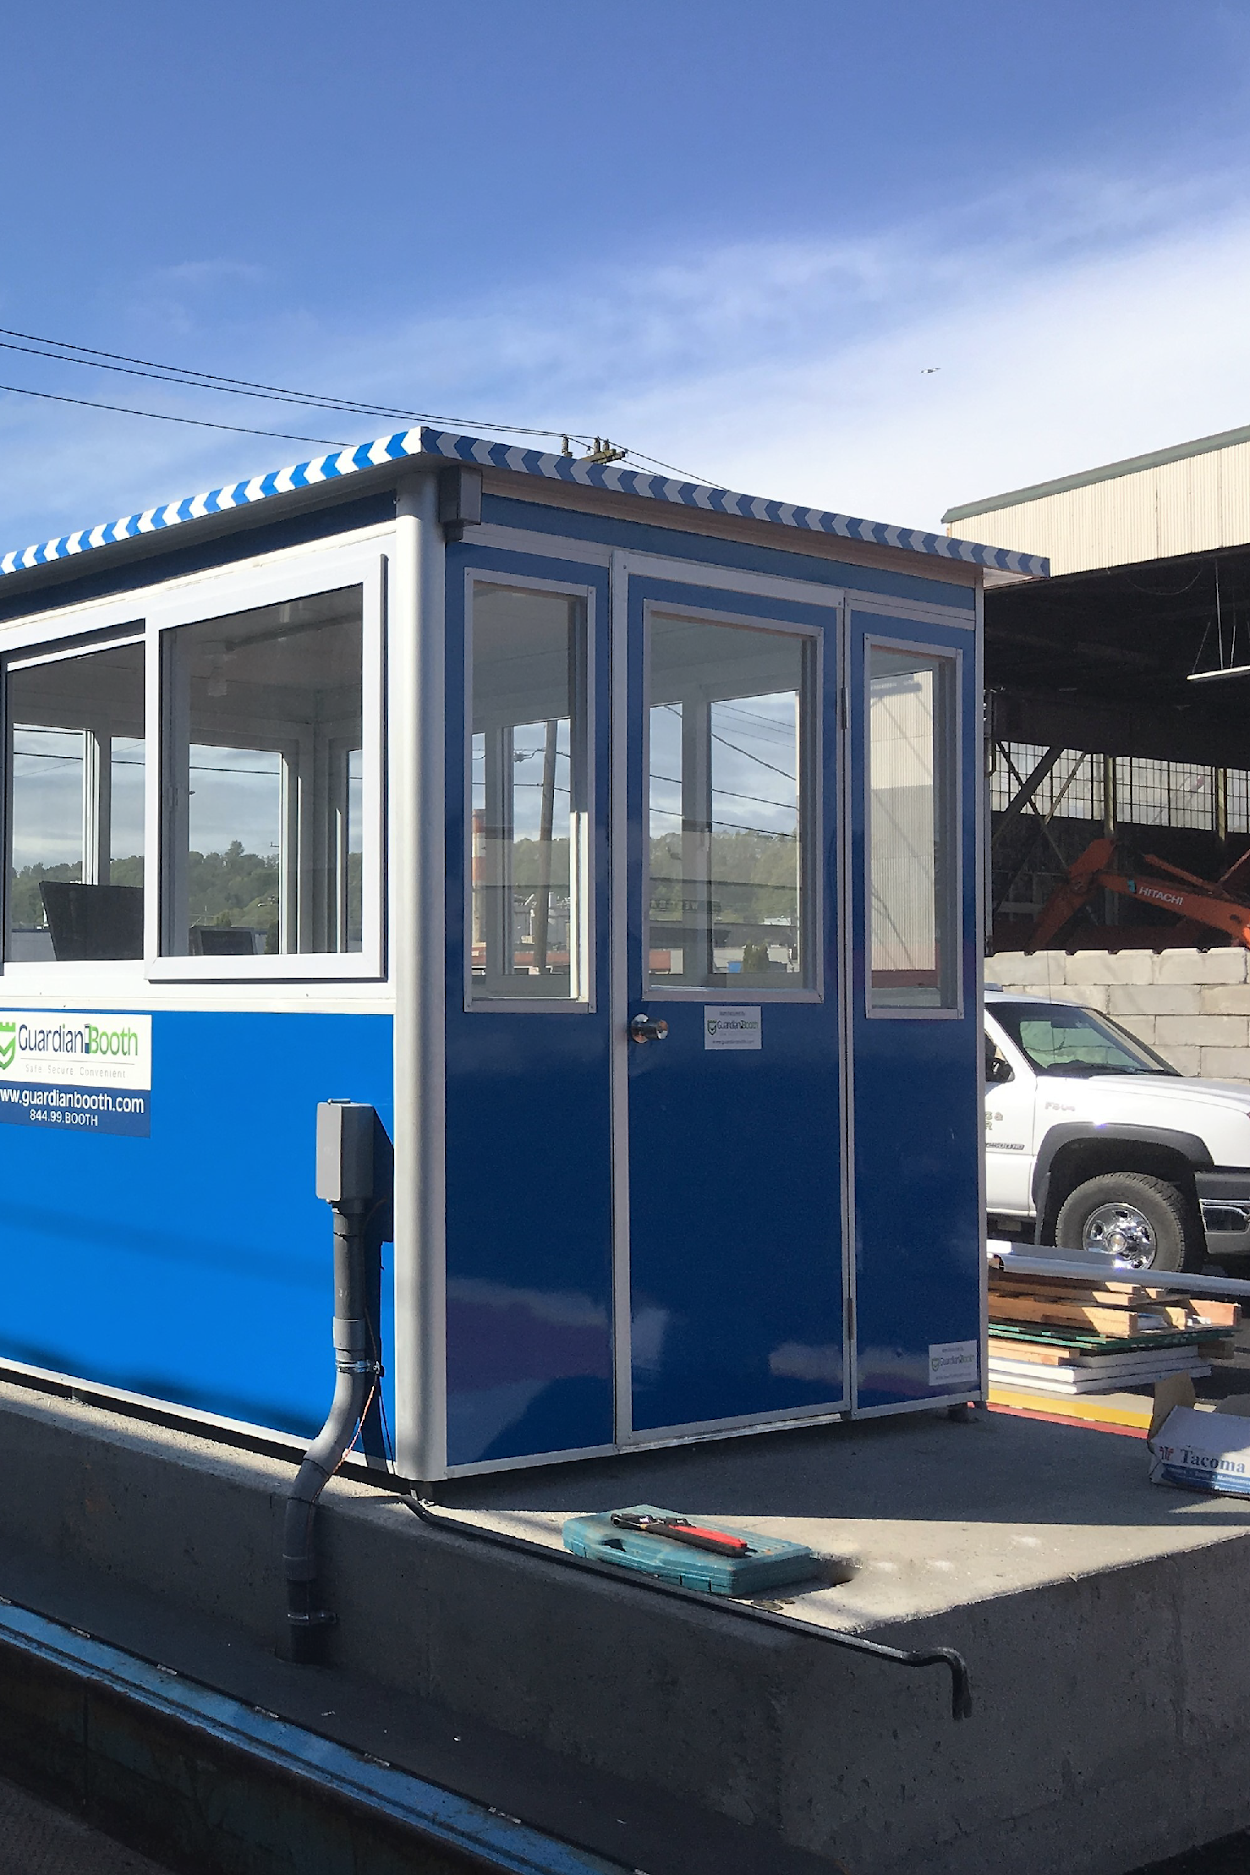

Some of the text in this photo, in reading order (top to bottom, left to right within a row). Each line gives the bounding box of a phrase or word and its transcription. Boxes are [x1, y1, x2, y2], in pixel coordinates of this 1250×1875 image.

[1139, 887, 1184, 905] HITACHI
[26, 1063, 126, 1079] Safe Secure Convenient
[29, 1108, 98, 1127] 844.99.BOOTH
[1180, 1448, 1245, 1474] Tacoma
